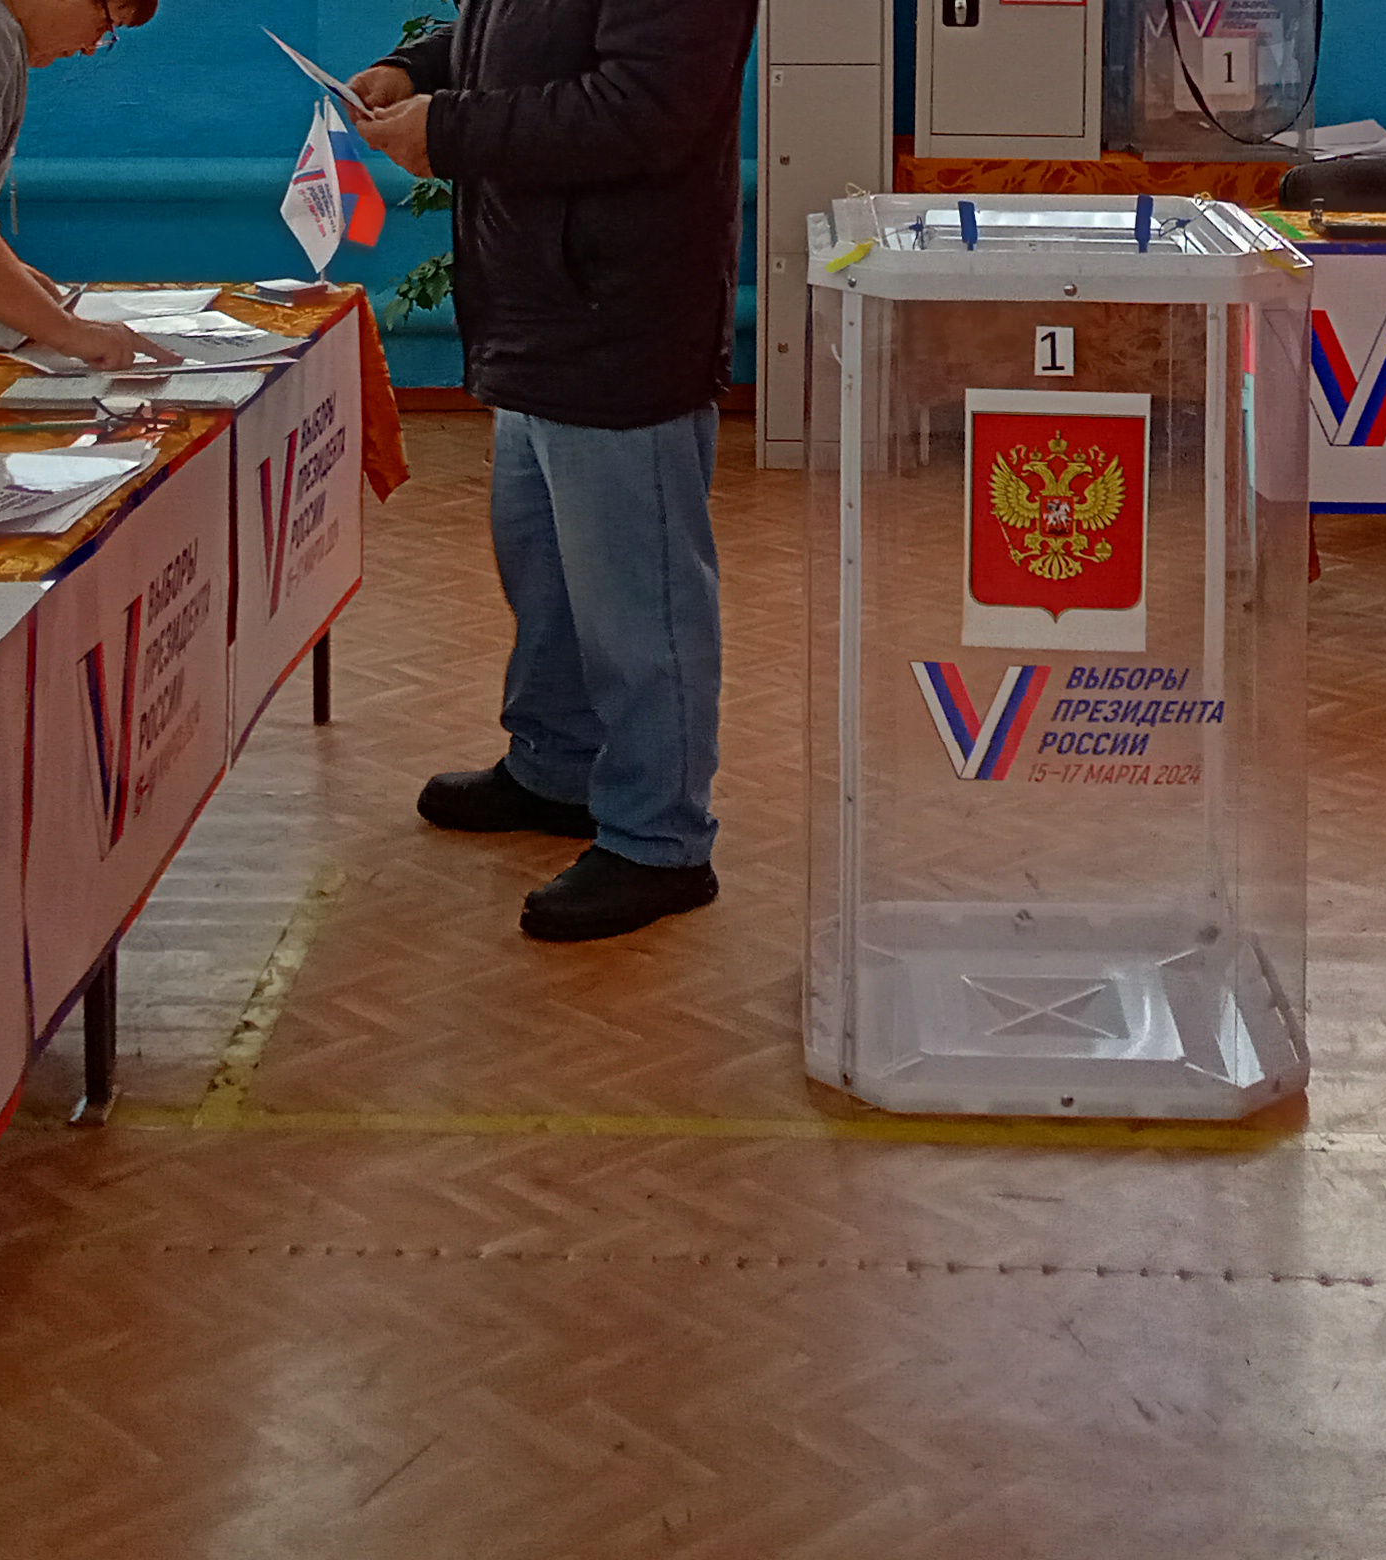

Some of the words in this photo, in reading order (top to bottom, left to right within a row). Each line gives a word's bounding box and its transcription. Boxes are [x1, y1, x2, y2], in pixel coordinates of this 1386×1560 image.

[1223, 51, 1235, 84] 1
[1040, 331, 1065, 371] 1
[1065, 666, 1190, 691] ВЫБОРЫ
[1051, 698, 1225, 727] ПРЕЗИДЕНТА
[1037, 731, 1151, 756] РОССИИ
[1083, 763, 1153, 785] МАРТА
[1153, 764, 1203, 786] 2024
